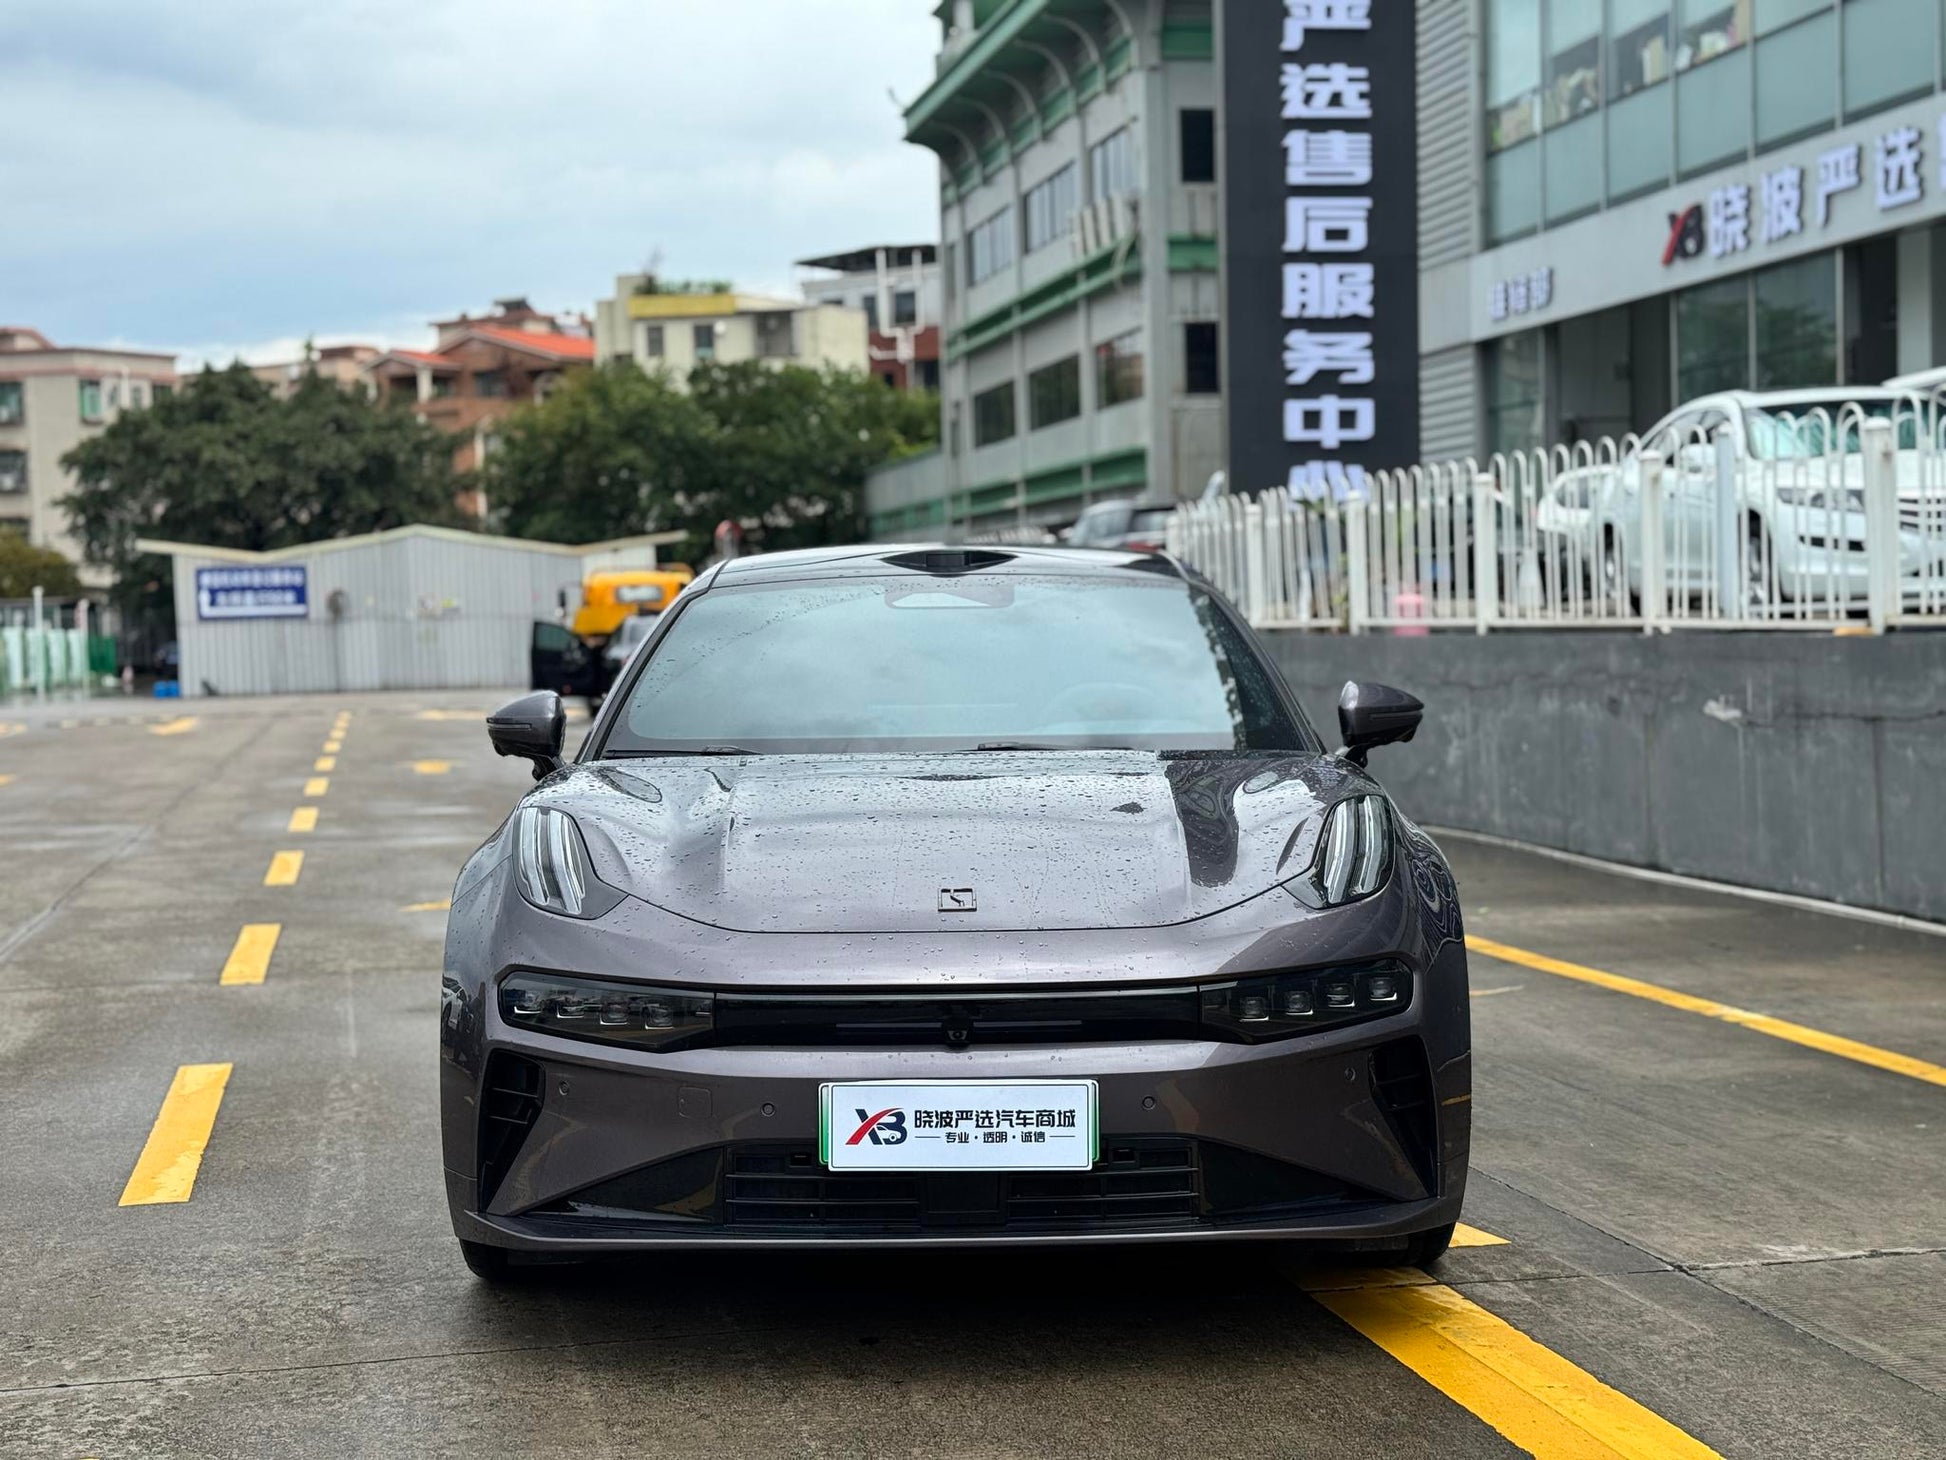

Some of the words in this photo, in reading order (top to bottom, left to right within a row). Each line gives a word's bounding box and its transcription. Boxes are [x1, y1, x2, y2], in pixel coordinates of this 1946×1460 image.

[1708, 112, 1946, 258] 晓波严选
[914, 1109, 1076, 1129] 晓波严选汽车商城
